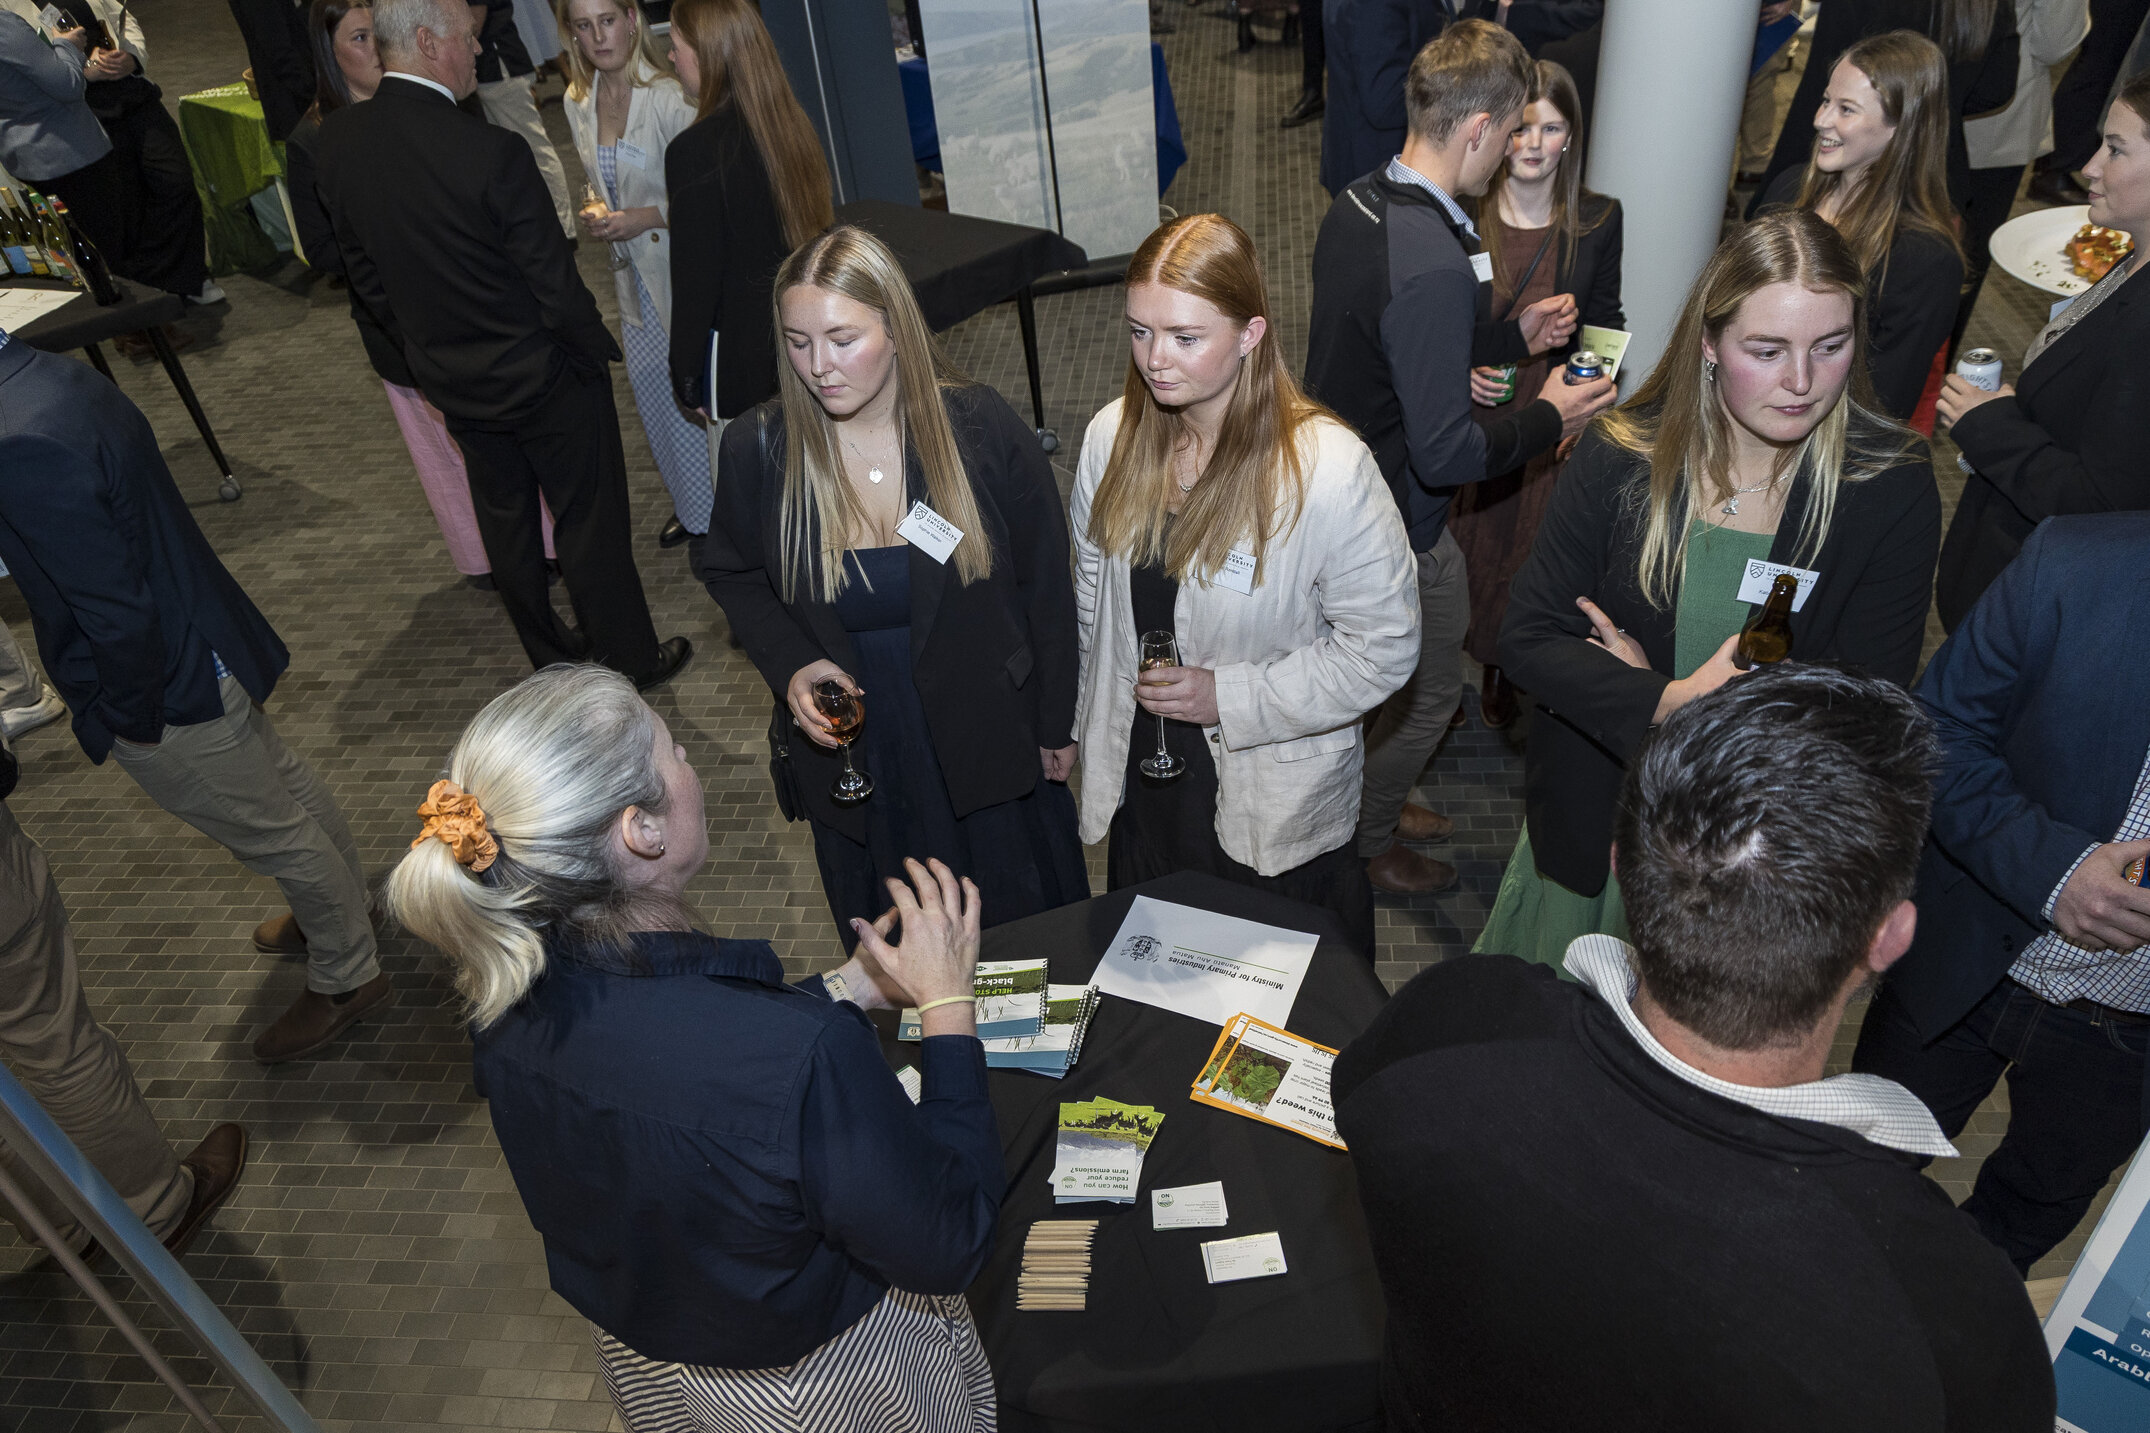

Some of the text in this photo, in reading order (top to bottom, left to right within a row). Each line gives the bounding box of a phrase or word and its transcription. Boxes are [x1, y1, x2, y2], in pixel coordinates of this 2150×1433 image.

[929, 515, 951, 530] LINCOLN
[927, 518, 957, 541] UNIVERSITY
[1228, 558, 1253, 568] VERSITY
[1768, 572, 1814, 584] UNSITY
[1769, 567, 1802, 576] LINCOLN
[1172, 950, 1194, 959] Matua
[1168, 956, 1284, 990] Ministry for Primary Industries
[1276, 1097, 1306, 1111] weed?
[1308, 1109, 1325, 1119] this
[2092, 1348, 2150, 1382] Arabl
